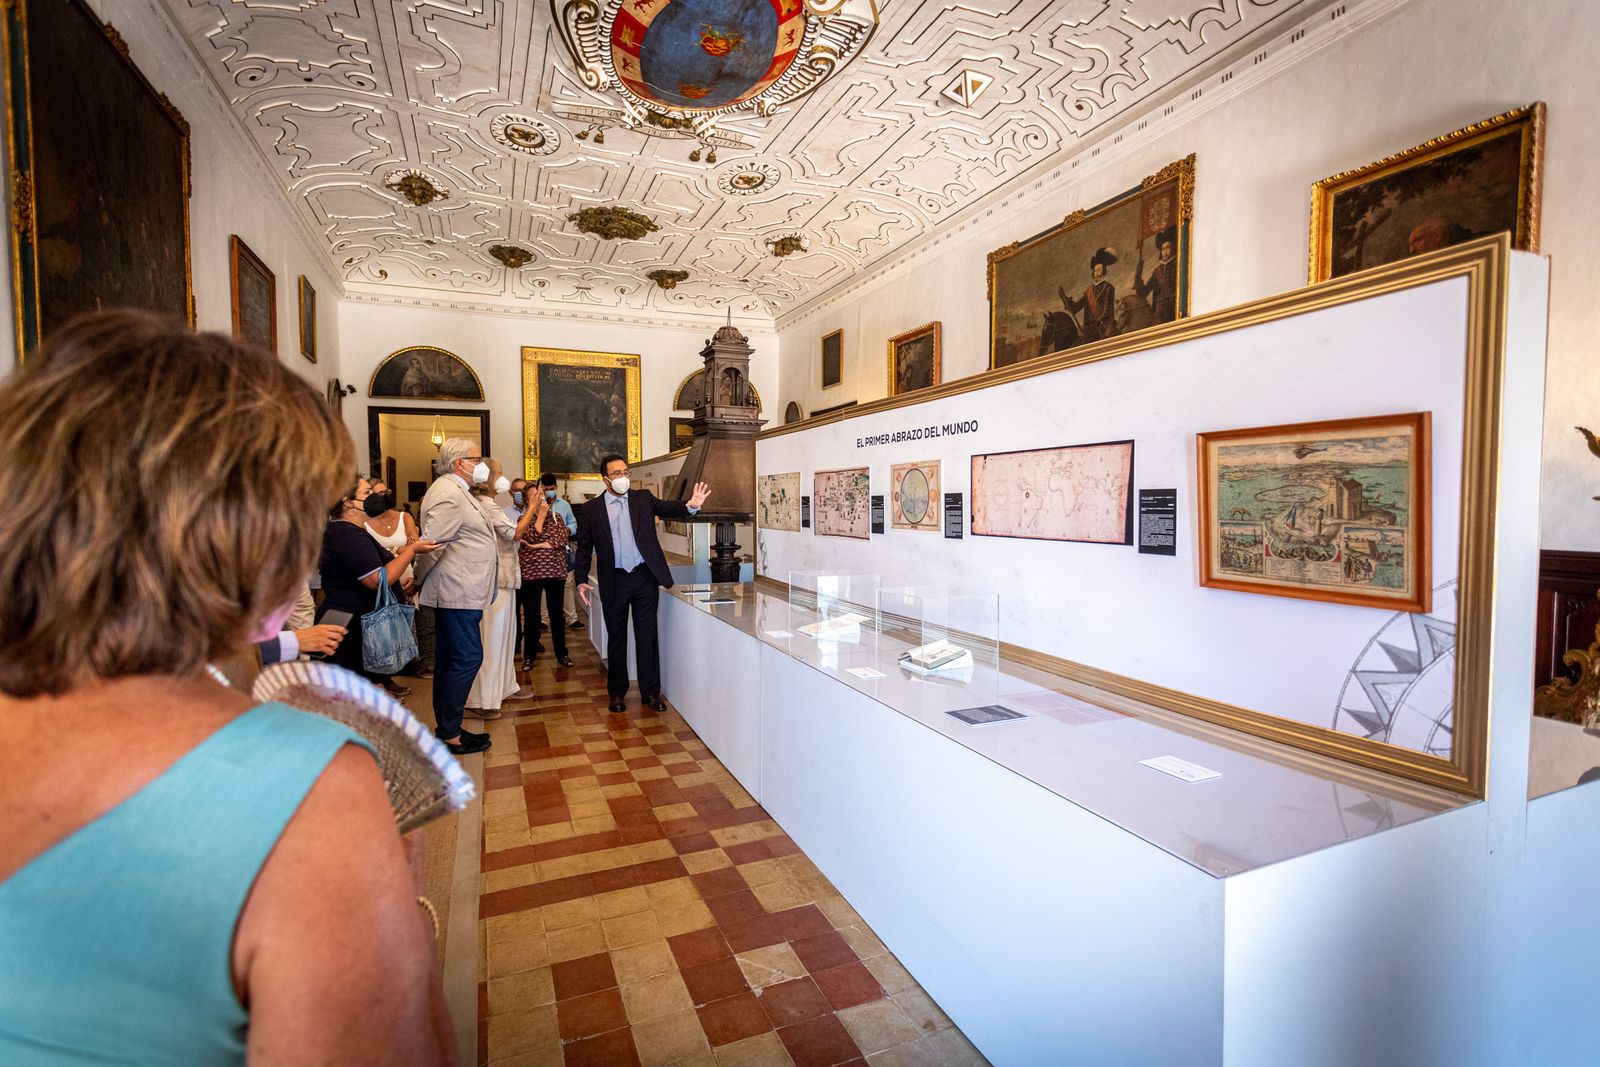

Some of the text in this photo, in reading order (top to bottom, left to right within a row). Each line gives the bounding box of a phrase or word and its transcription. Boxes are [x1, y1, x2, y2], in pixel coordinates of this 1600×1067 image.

[857, 420, 979, 448] EL PRIMER ABRAZO DEL MUNDO
